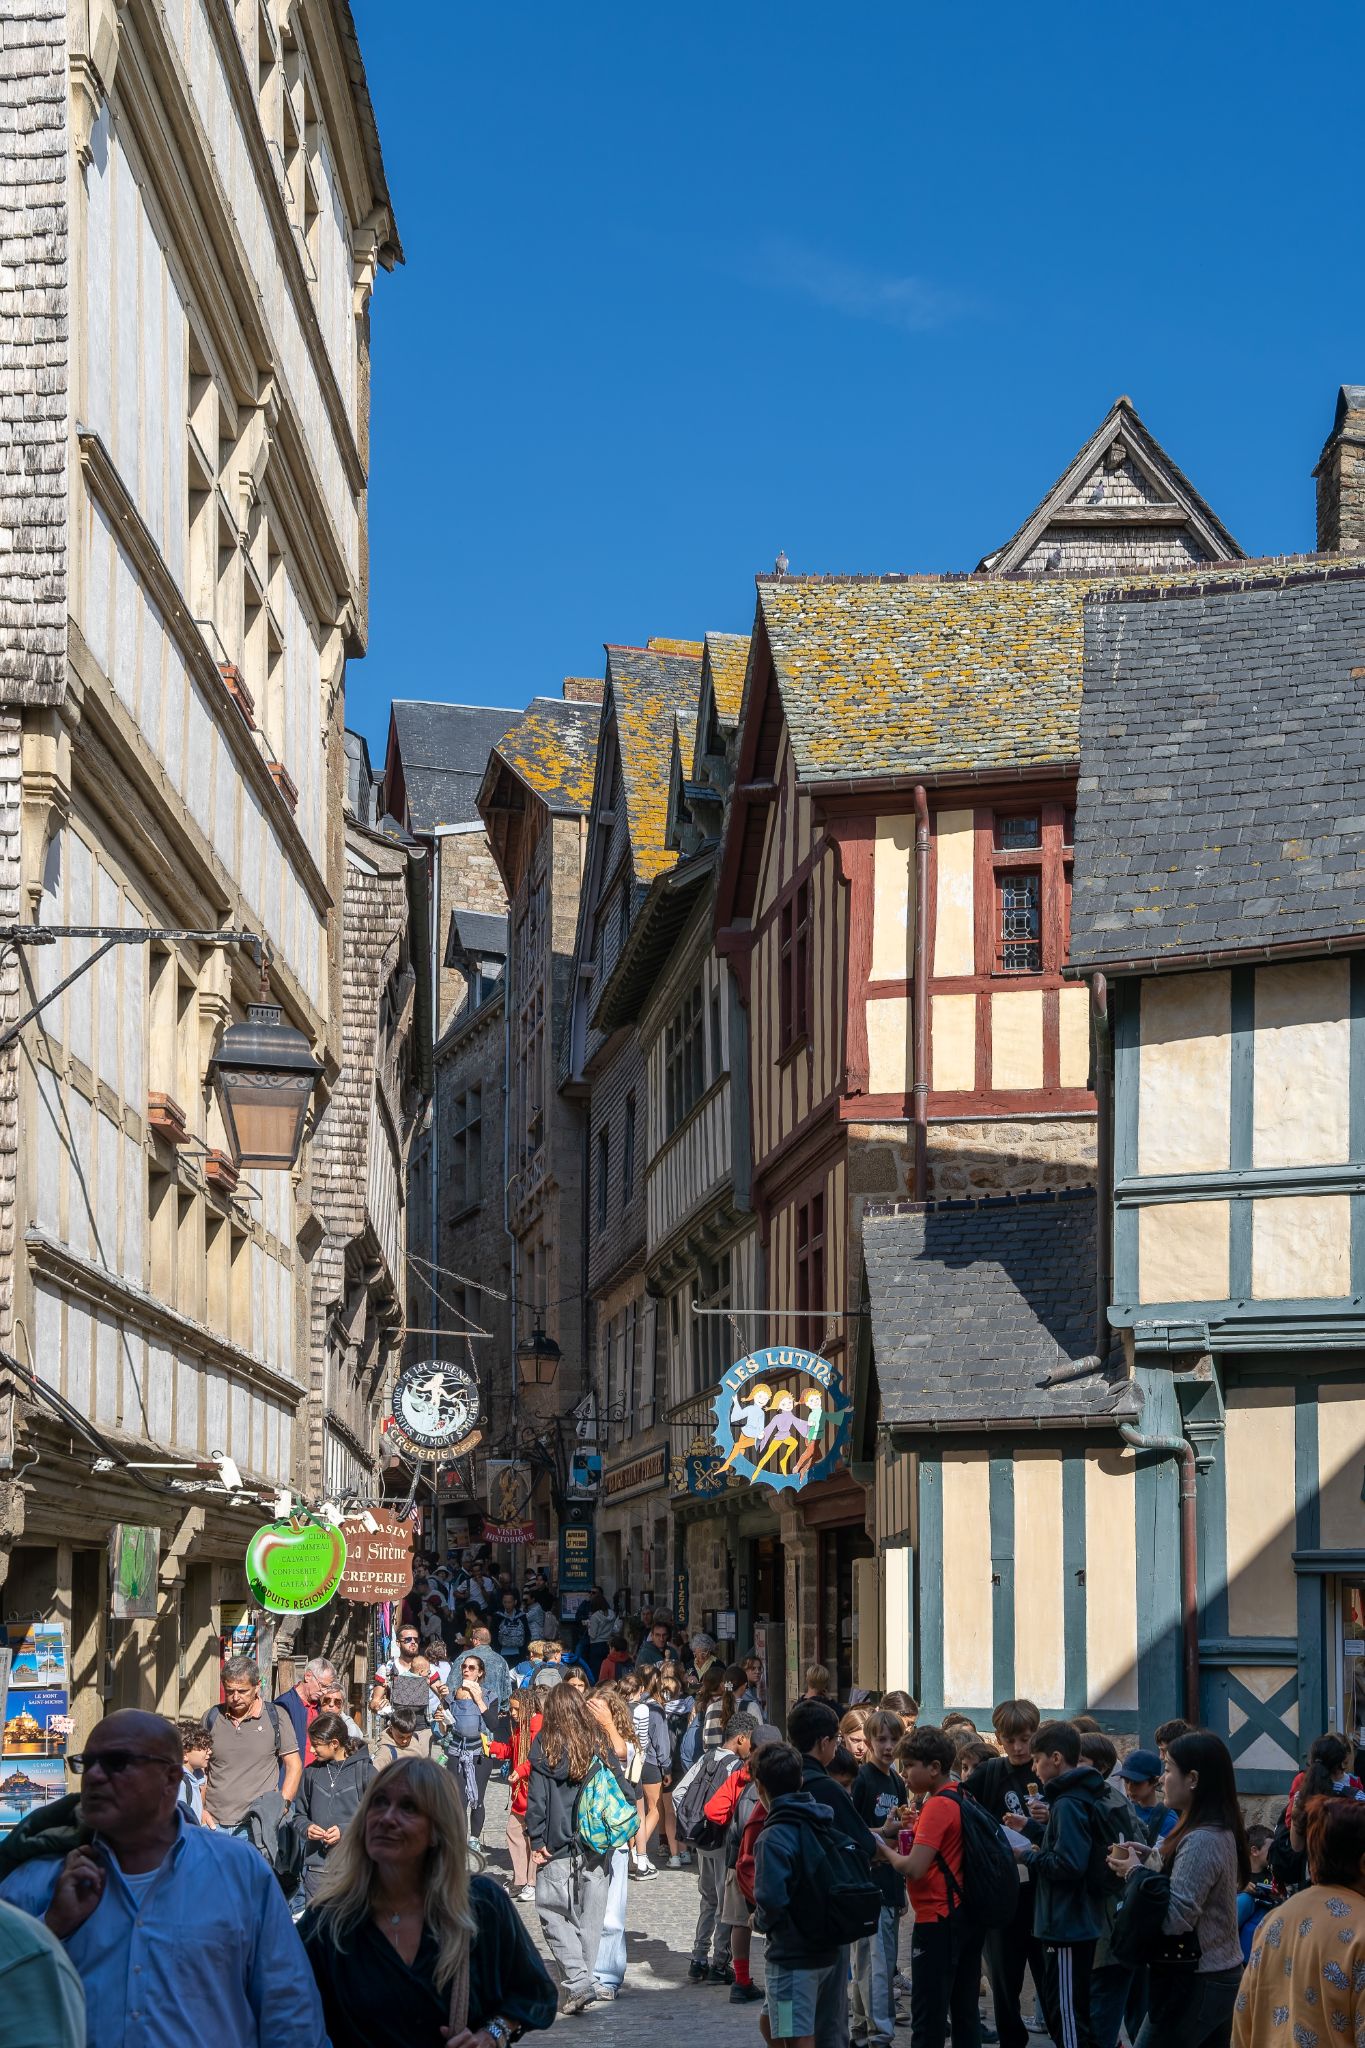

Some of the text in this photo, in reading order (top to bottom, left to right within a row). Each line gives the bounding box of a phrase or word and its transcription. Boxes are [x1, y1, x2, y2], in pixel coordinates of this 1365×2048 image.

[413, 1362, 428, 1374] LA
[726, 1351, 838, 1391] LES LUTINS
[393, 1386, 414, 1435] SOUVENIRS
[415, 1434, 427, 1442] DU
[429, 1434, 455, 1445] MONT
[465, 1395, 479, 1430] MICHEL
[345, 1524, 409, 1539] MAASIN
[486, 1532, 535, 1544] HISTORIQUE
[496, 1527, 523, 1536] VISITE
[346, 1542, 407, 1562] La Sirène
[282, 1555, 320, 1563] CALVADOS
[272, 1567, 318, 1575] CONFISERIE
[341, 1570, 406, 1584] CREPERIE
[251, 1577, 290, 1608] PRODUITS
[373, 1585, 399, 1596] étage
